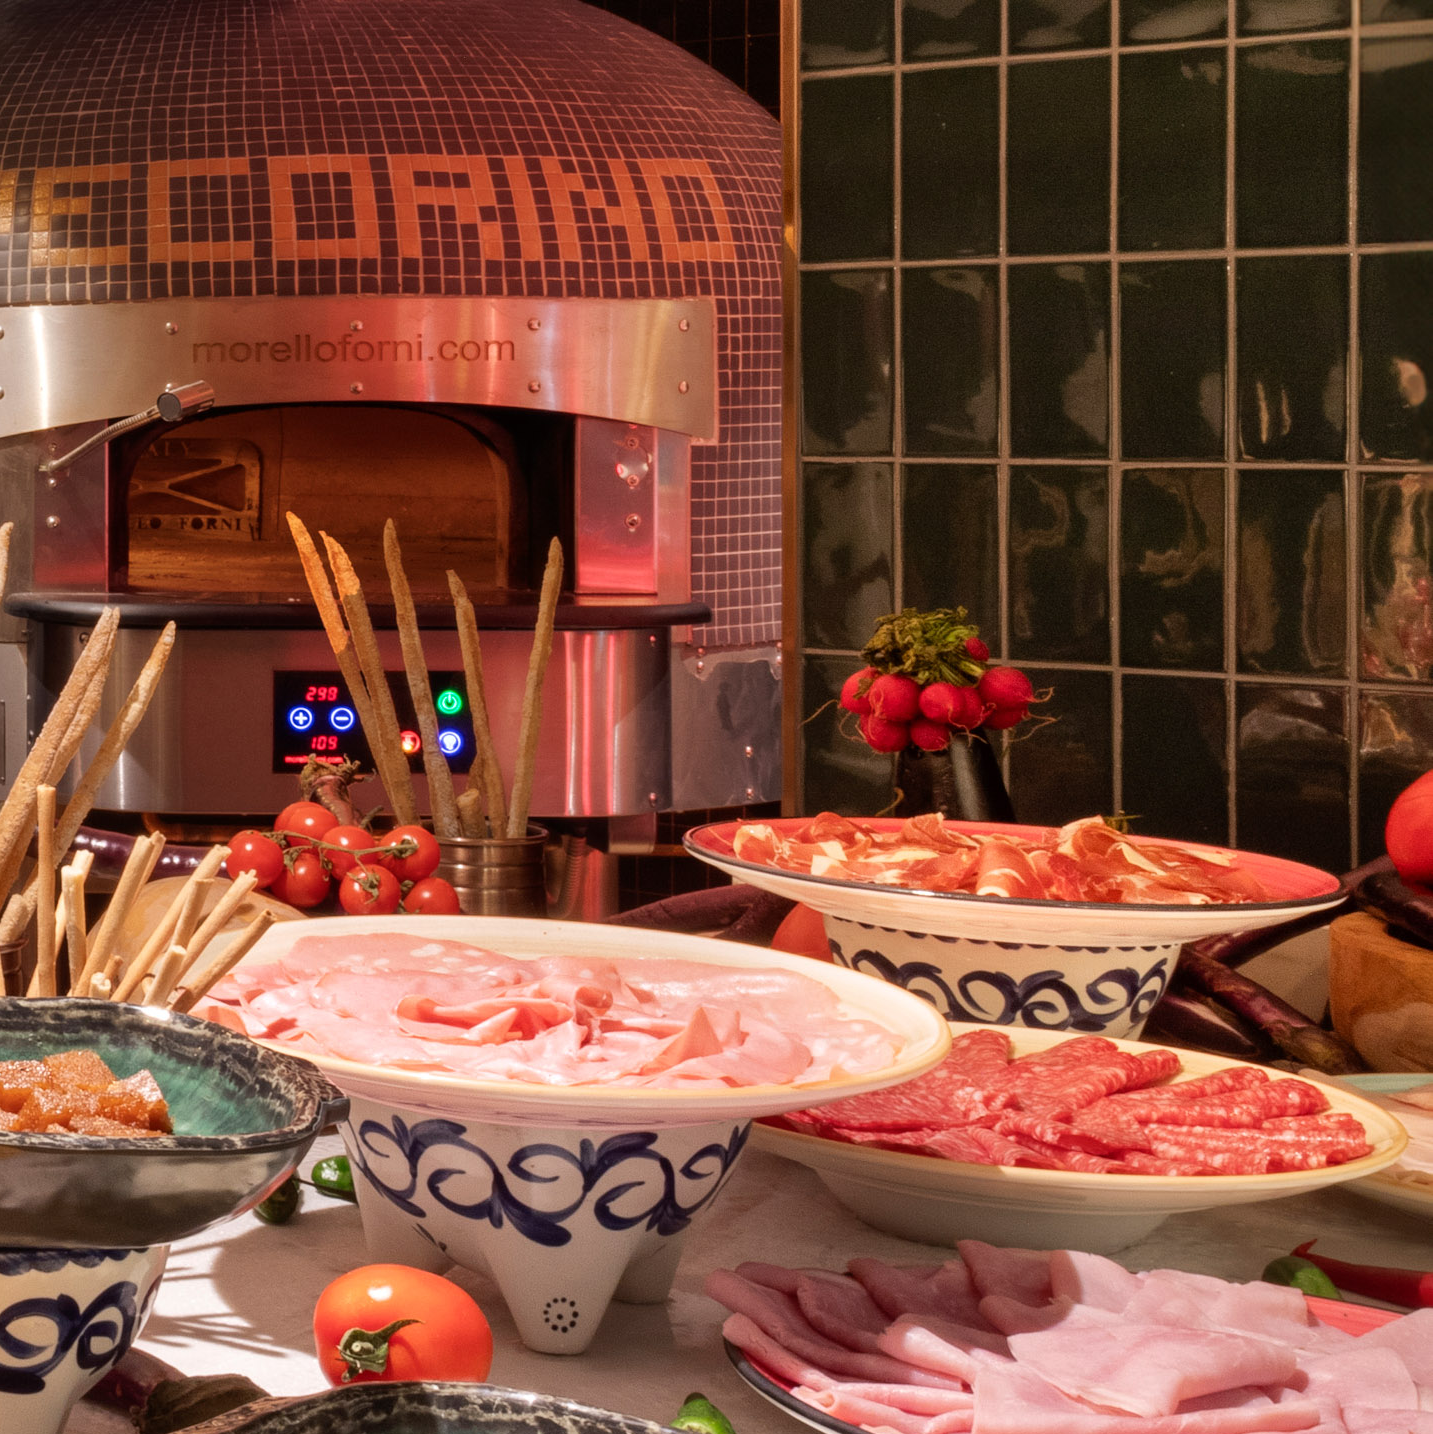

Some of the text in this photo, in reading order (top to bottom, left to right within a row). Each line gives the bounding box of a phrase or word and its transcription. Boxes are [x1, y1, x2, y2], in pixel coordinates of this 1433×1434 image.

[191, 333, 517, 366] morelloforni.com
[180, 516, 242, 531] FORNI
[310, 734, 338, 750] 109
